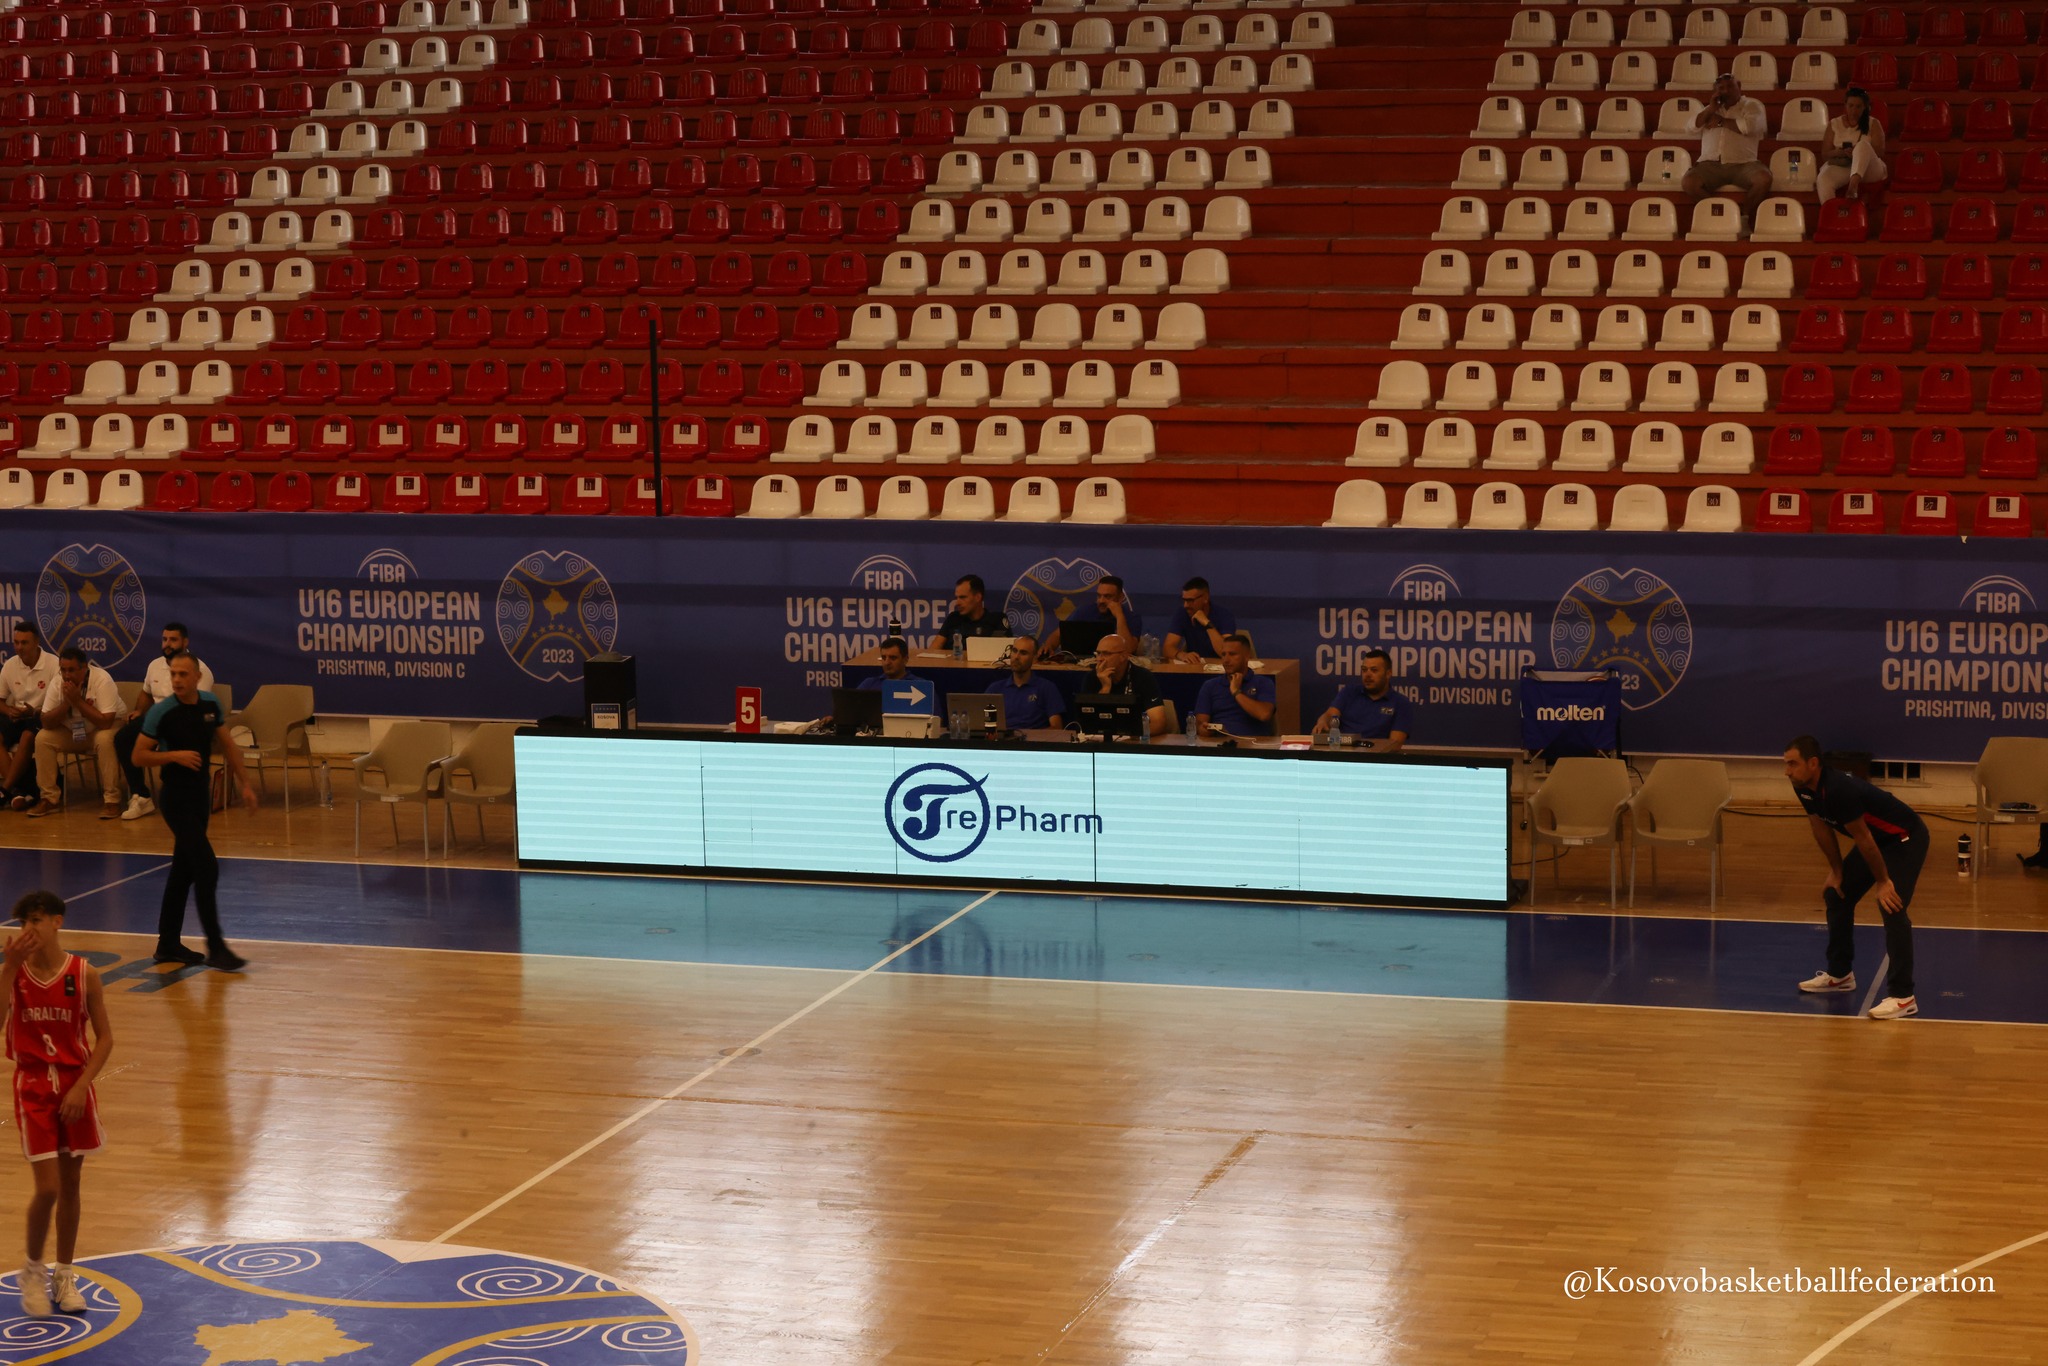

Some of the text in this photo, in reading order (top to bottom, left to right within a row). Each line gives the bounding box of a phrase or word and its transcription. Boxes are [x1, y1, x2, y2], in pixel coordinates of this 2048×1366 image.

[369, 564, 405, 583] FIBA
[865, 570, 904, 590] FIBA
[1404, 580, 1446, 602] FIBA
[299, 589, 480, 621] U16 EUROPEAN
[786, 597, 833, 627] U16
[1976, 592, 2020, 613] FIBA
[1318, 608, 1532, 643] U16 EUROPEAN
[77, 637, 106, 652] 2023
[298, 623, 484, 655] CHAMPIONSHIP
[1886, 620, 2048, 655] U16 EUROP
[542, 649, 574, 664] 2023
[318, 659, 465, 679] PRISHTINA, DIVISION C
[1882, 658, 2048, 693] CHAMPION
[1430, 687, 1496, 705] DIVISION
[1502, 688, 1512, 706] C
[741, 696, 756, 724] 5
[1537, 705, 1605, 721] molten
[1905, 700, 1996, 721] PRISHTINA,
[996, 805, 1102, 834] Pharm
[42, 1033, 57, 1056] 8
